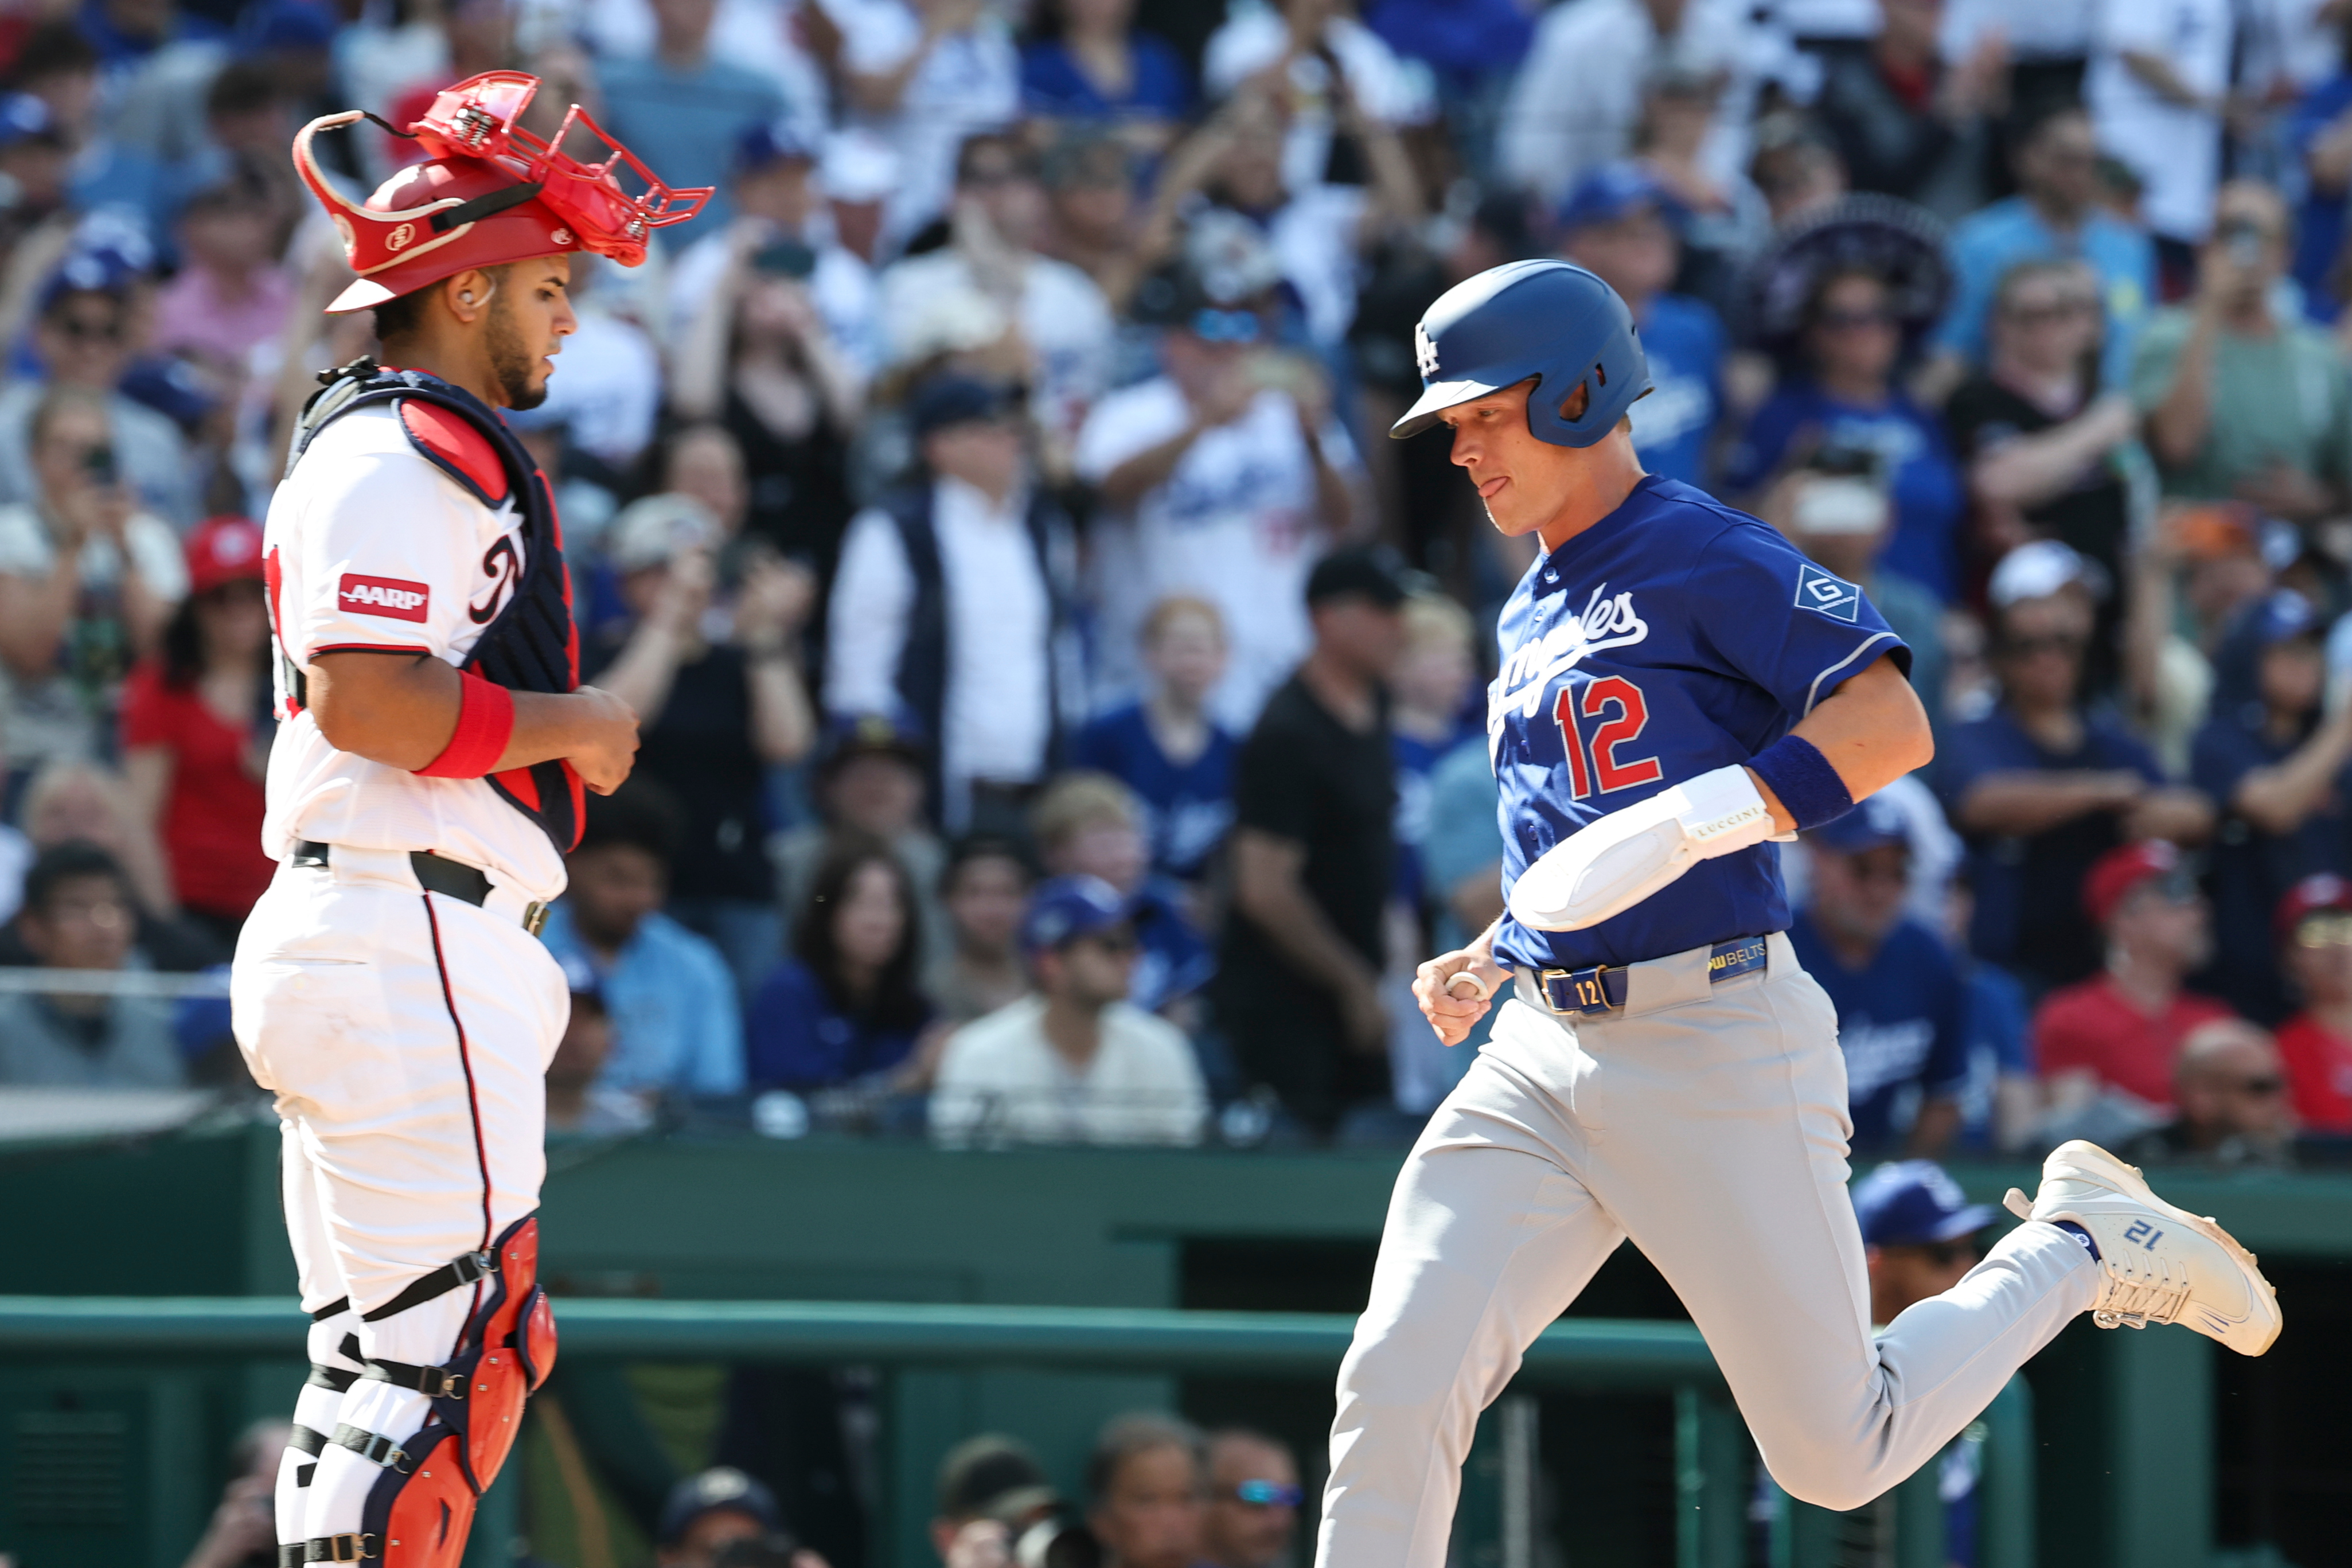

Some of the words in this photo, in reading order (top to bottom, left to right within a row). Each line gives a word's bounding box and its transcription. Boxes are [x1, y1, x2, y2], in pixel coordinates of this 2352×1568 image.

[1415, 322, 1440, 378] LA
[340, 584, 426, 610] AARP
[1806, 578, 1843, 602] G
[1552, 674, 1663, 800] 12
[1697, 807, 1760, 836] LUCCINI
[1575, 980, 1600, 1005] 12
[2123, 1219, 2164, 1252] 12
